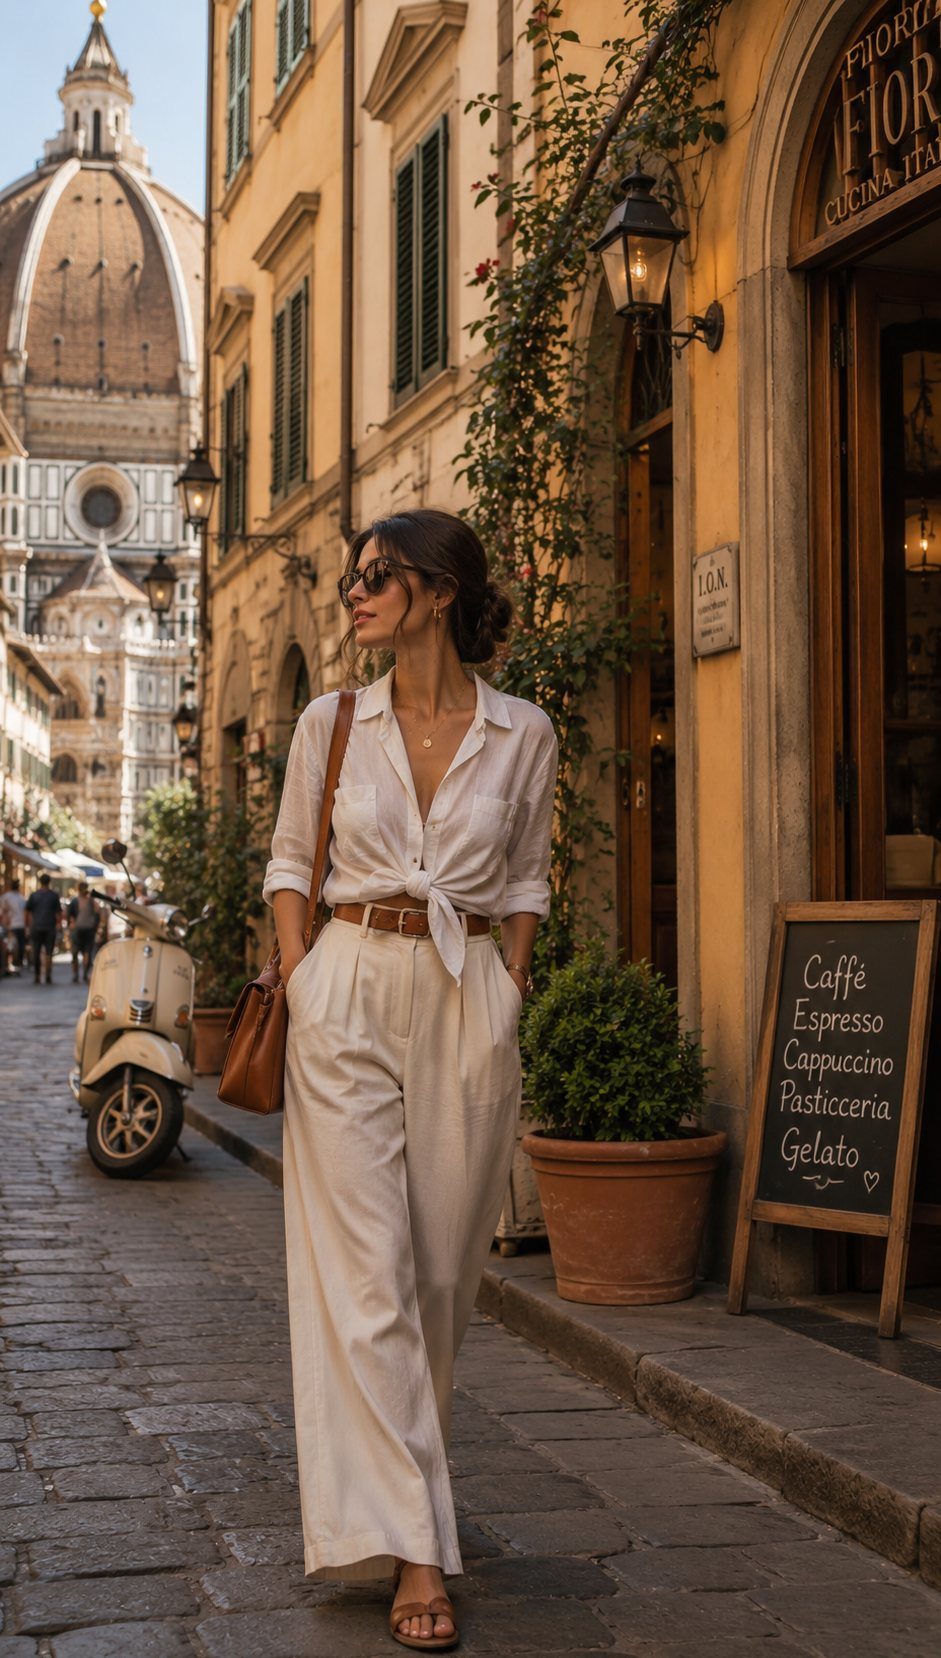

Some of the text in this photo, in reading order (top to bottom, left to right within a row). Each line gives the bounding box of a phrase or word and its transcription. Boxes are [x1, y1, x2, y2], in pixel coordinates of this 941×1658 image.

[824, 168, 896, 226] CUCINA
[698, 566, 728, 597] I.O.N.
[803, 954, 866, 1000] Caffé
[793, 998, 884, 1042] Espresso
[783, 1038, 894, 1082] Cappuccino
[780, 1079, 892, 1120] Pasticceria
[781, 1127, 859, 1171] Gelato
